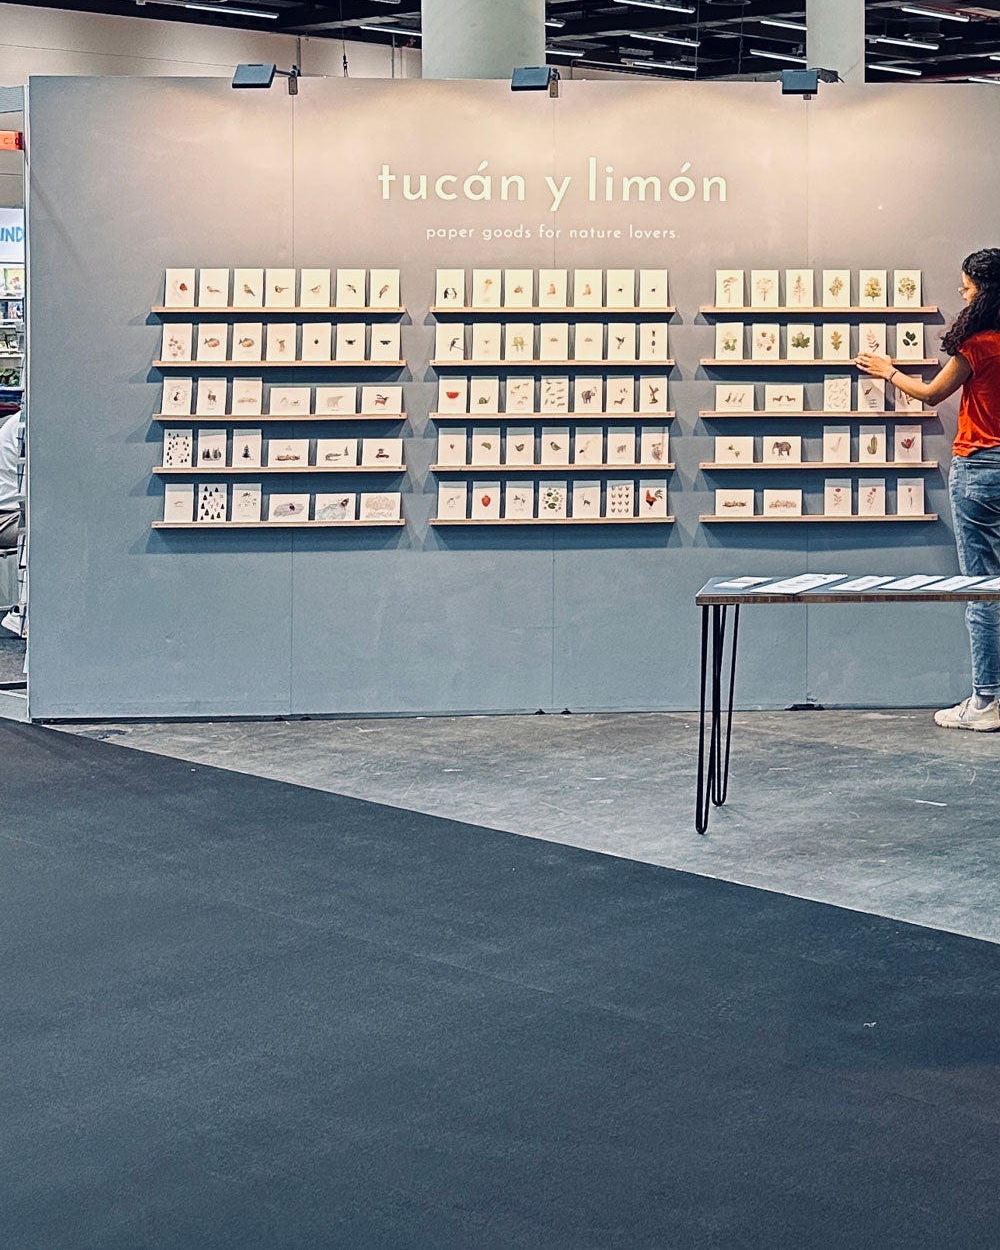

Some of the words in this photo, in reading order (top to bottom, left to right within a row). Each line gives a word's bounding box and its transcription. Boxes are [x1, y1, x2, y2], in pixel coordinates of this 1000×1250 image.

[377, 160, 526, 201] tucán
[544, 176, 572, 212] y
[588, 157, 727, 202] limón
[426, 228, 475, 240] paper
[482, 225, 532, 241] goods
[539, 224, 562, 239] for
[569, 227, 622, 240] nature
[629, 225, 680, 239] lovers.
